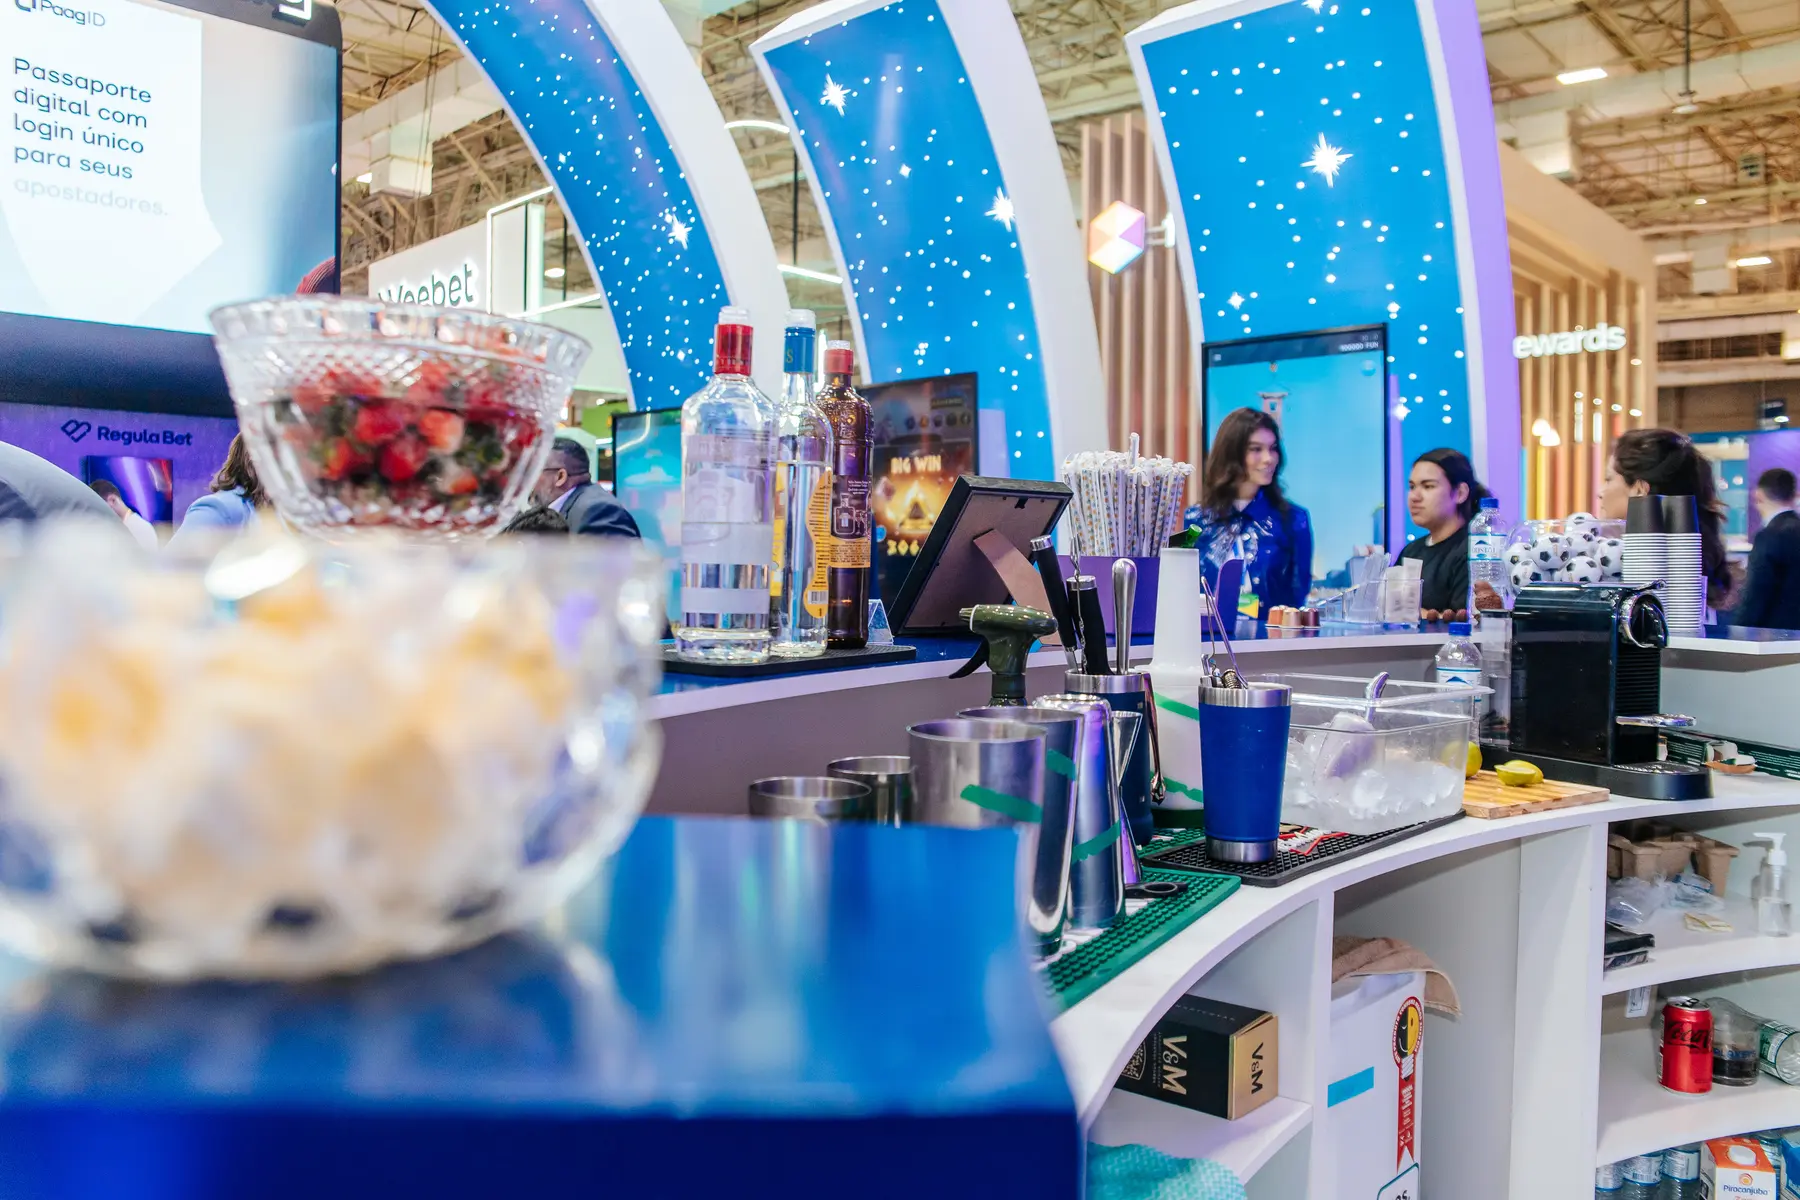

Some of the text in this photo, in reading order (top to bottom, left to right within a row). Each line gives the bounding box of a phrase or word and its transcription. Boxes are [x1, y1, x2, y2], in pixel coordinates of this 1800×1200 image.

[14, 57, 151, 103] Passaporte
[14, 86, 147, 128] digital com
[14, 112, 144, 153] login único
[14, 146, 133, 179] para seus
[13, 178, 168, 216] apostadores.
[914, 454, 942, 473] WIN
[1162, 1035, 1188, 1095] V&M
[1251, 1041, 1264, 1095] V&M
